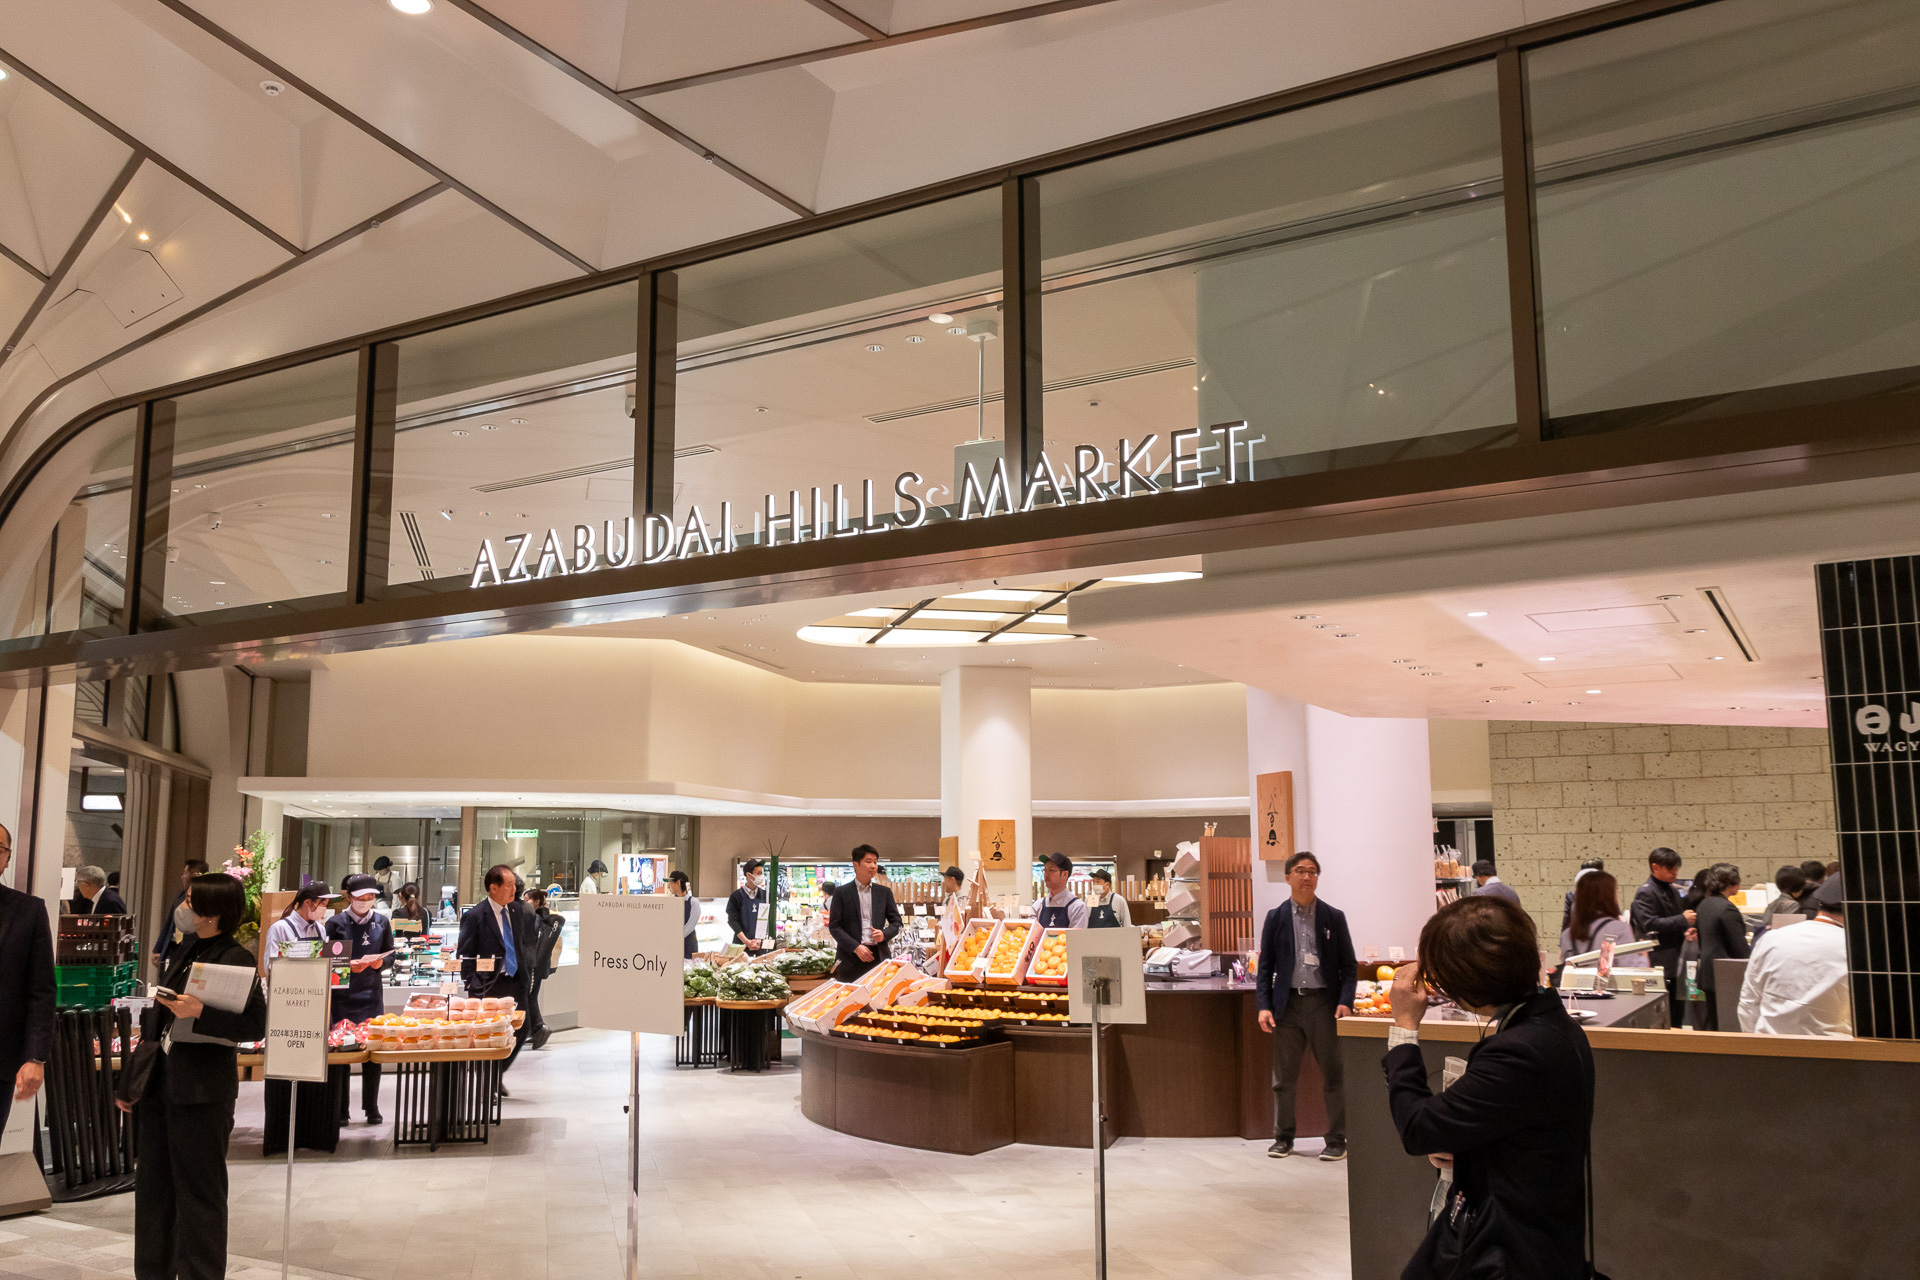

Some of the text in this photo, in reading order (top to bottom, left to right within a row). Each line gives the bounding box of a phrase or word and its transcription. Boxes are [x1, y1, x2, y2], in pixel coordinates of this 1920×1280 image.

[471, 419, 1249, 589] AZABUDAI HILLS MARKET
[593, 950, 667, 977] Press Only
[273, 987, 324, 996] AZABUDAI HILLS
[285, 999, 310, 1008] MARKET
[286, 1040, 305, 1049] OPEN
